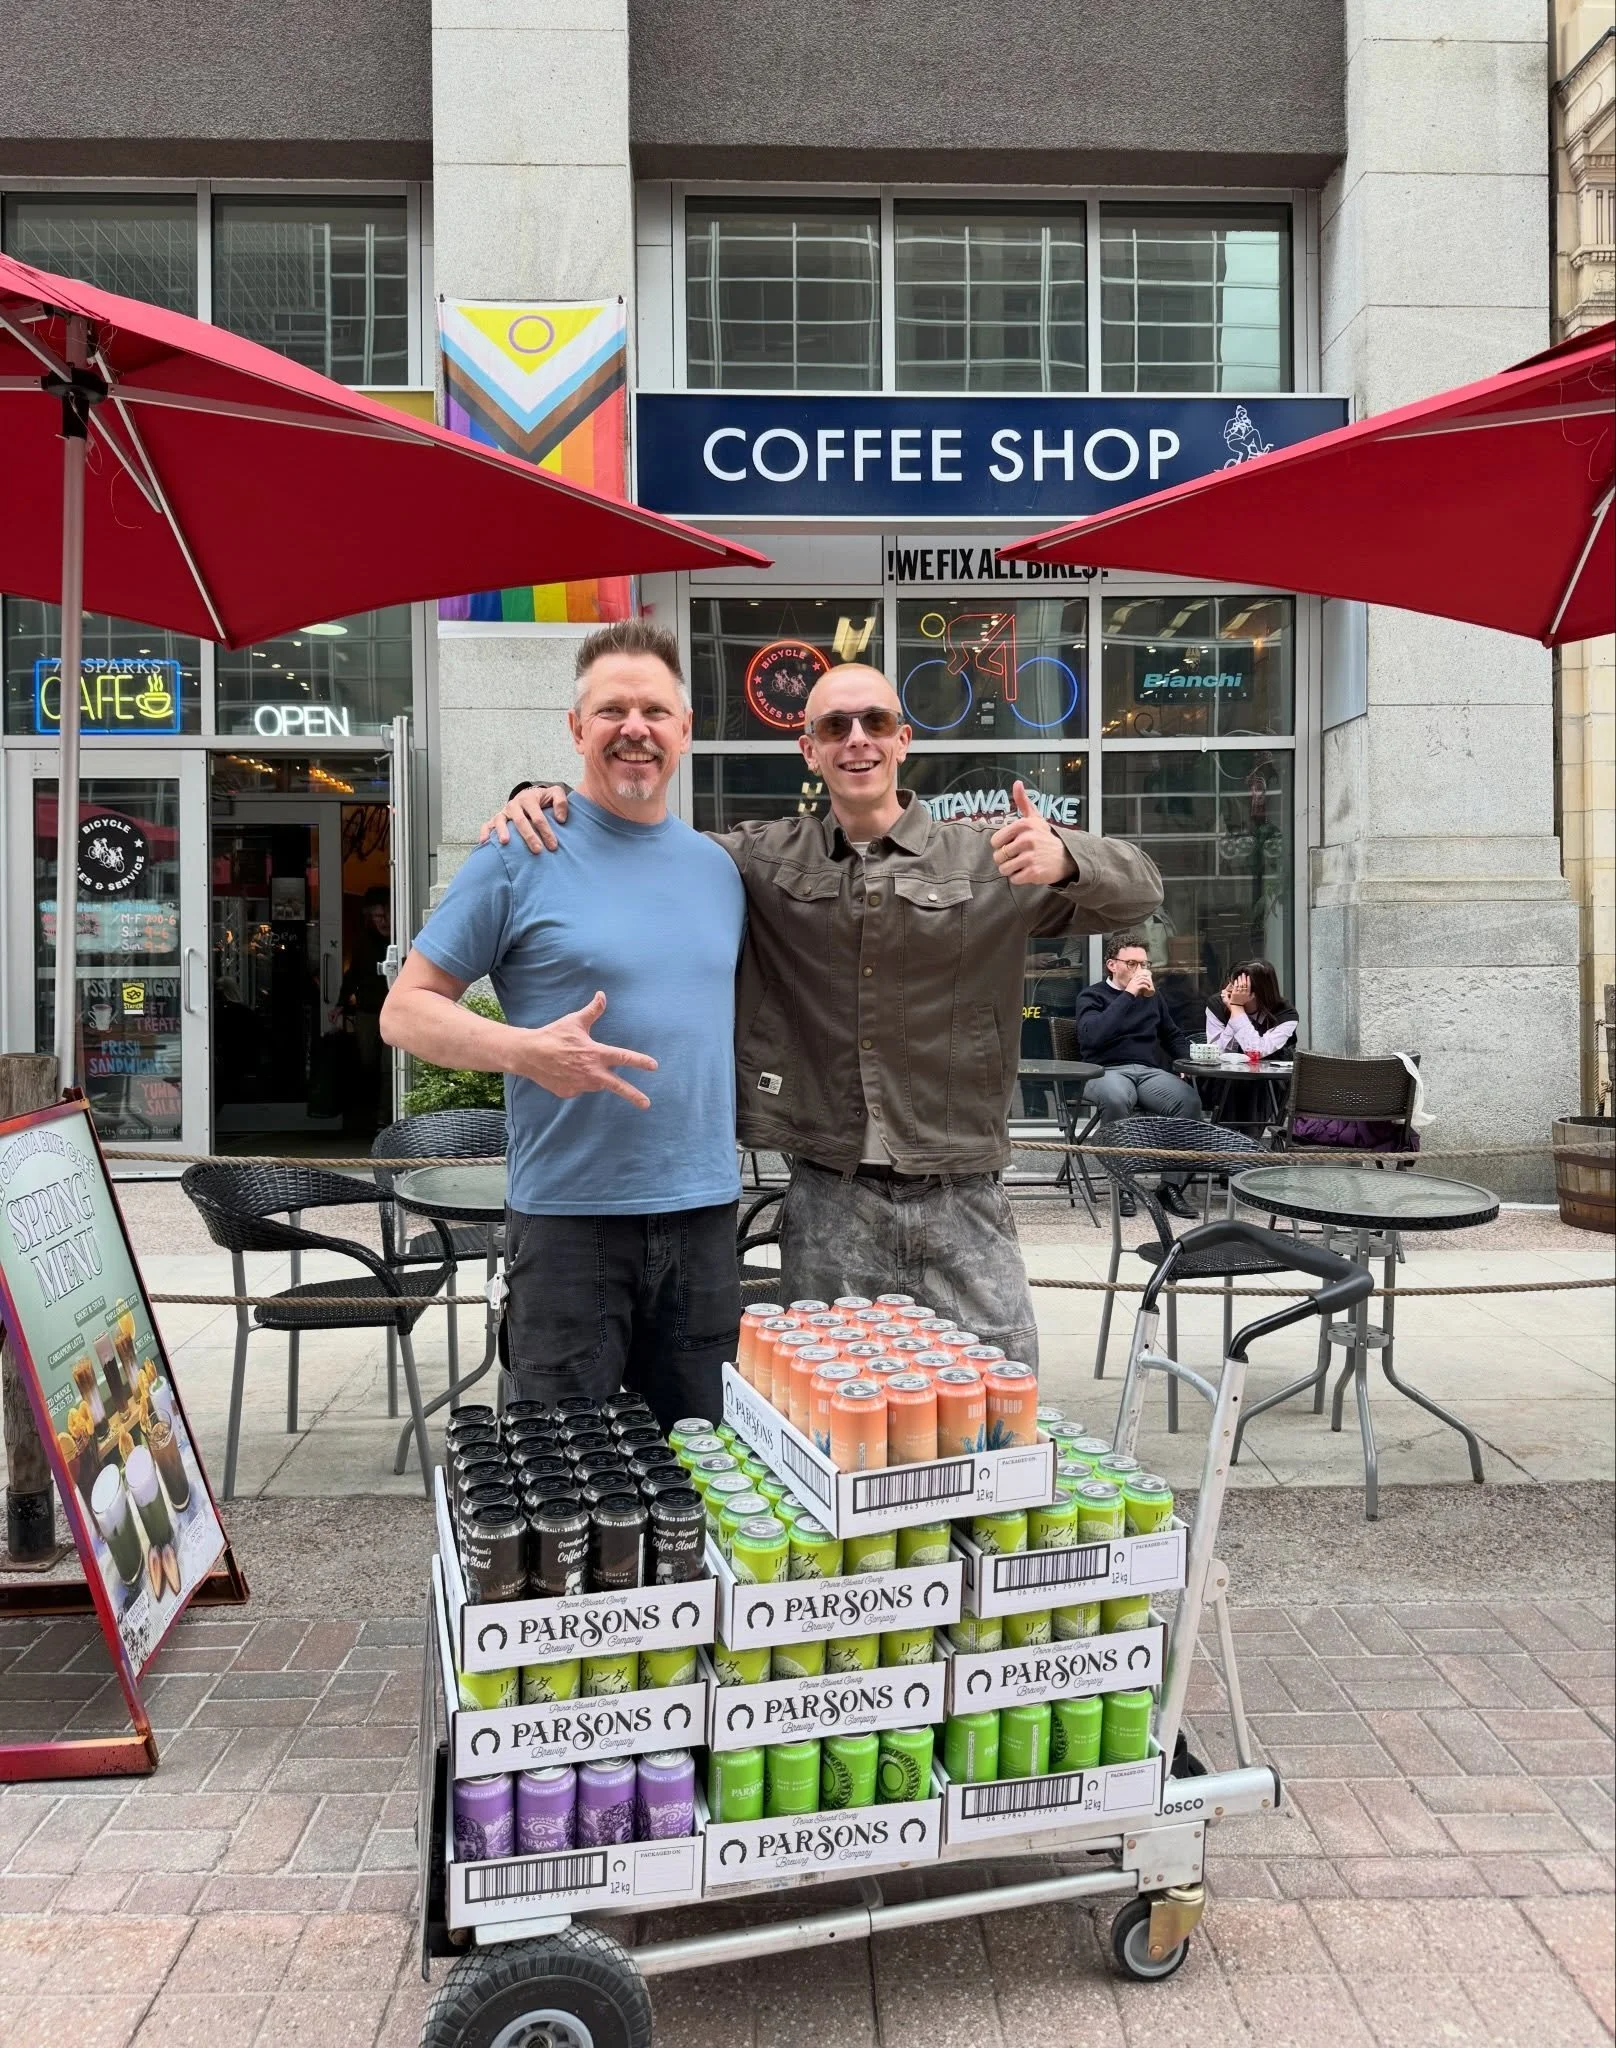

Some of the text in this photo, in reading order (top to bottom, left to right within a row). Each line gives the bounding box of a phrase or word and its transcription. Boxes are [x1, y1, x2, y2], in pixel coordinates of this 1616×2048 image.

[703, 427, 1180, 482] COFFEE SHOP
[937, 549, 973, 580] FIX
[977, 549, 1023, 579] ALL
[84, 658, 161, 674] SPARKS
[761, 649, 806, 669] BICYCLE
[1143, 672, 1243, 688] Bianchi
[756, 690, 782, 718] SALES
[786, 712, 794, 720] &
[254, 705, 350, 737] OPEN
[81, 819, 131, 834] BICYCLE
[95, 882, 104, 890] &
[108, 855, 145, 891] SERVICE
[1022, 1006, 1042, 1019] AFE
[101, 1040, 142, 1056] FRESH
[0, 1132, 41, 1185] OTTAWA
[38, 1131, 66, 1157] BIKE
[6, 1171, 96, 1255] SPRING
[30, 1226, 104, 1308] MENU
[976, 1488, 994, 1502] 12 kg
[975, 1528, 995, 1541] ンダ
[652, 1536, 698, 1552] Coffee Stout
[470, 1555, 492, 1570] Stout
[557, 1549, 582, 1565] Coffee
[791, 1552, 819, 1567] ンダ
[1111, 1572, 1128, 1584] 12 kg
[783, 1584, 913, 1626] PARSONS
[518, 1604, 660, 1649] PARSONS
[801, 1621, 836, 1633] Brewing
[538, 1641, 576, 1656] Brewing
[830, 1646, 859, 1660] ンダ
[587, 1666, 628, 1684] リンダ
[716, 1659, 741, 1675] ンダ
[1000, 1648, 1118, 1690] PARSONS
[525, 1674, 553, 1691] ンダ
[1016, 1684, 1048, 1697] Brewing
[764, 1684, 893, 1727] PARSONS
[511, 1707, 652, 1751] PARSONS
[781, 1721, 816, 1734] Brewing
[531, 1745, 567, 1760] Brewing
[1084, 1799, 1101, 1812] 12 kg
[1155, 1798, 1204, 1817] OSCO
[986, 1815, 996, 1823] 06
[756, 1820, 889, 1861] PARSONS
[775, 1855, 810, 1868] Brewing
[610, 1881, 631, 1894] 12 kg
[494, 1899, 506, 1907] 06
[513, 1894, 543, 1905] 27843
[549, 1889, 579, 1900] 75799
